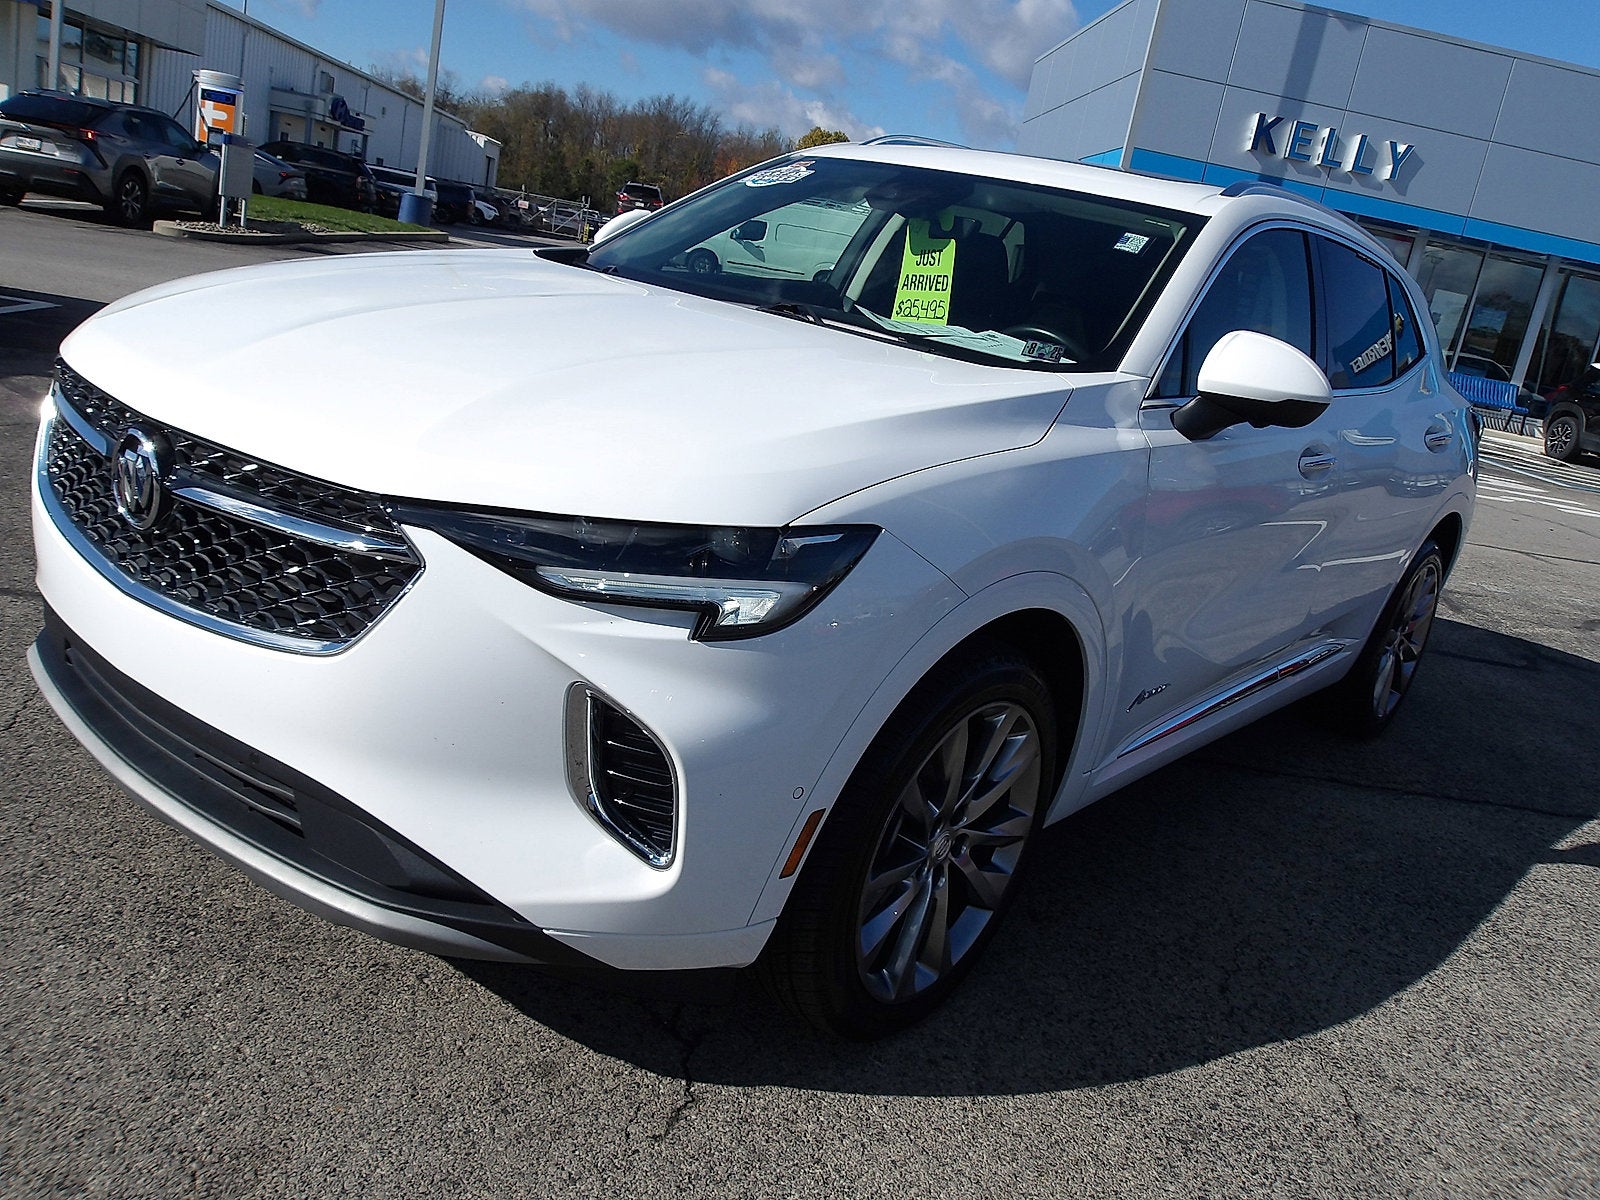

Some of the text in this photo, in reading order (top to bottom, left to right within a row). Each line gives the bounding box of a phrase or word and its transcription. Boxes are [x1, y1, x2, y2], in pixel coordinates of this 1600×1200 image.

[1248, 112, 1416, 181] KELLY
[915, 249, 944, 267] JUST
[901, 274, 949, 292] ARRIVED
[895, 299, 946, 320] $25,495
